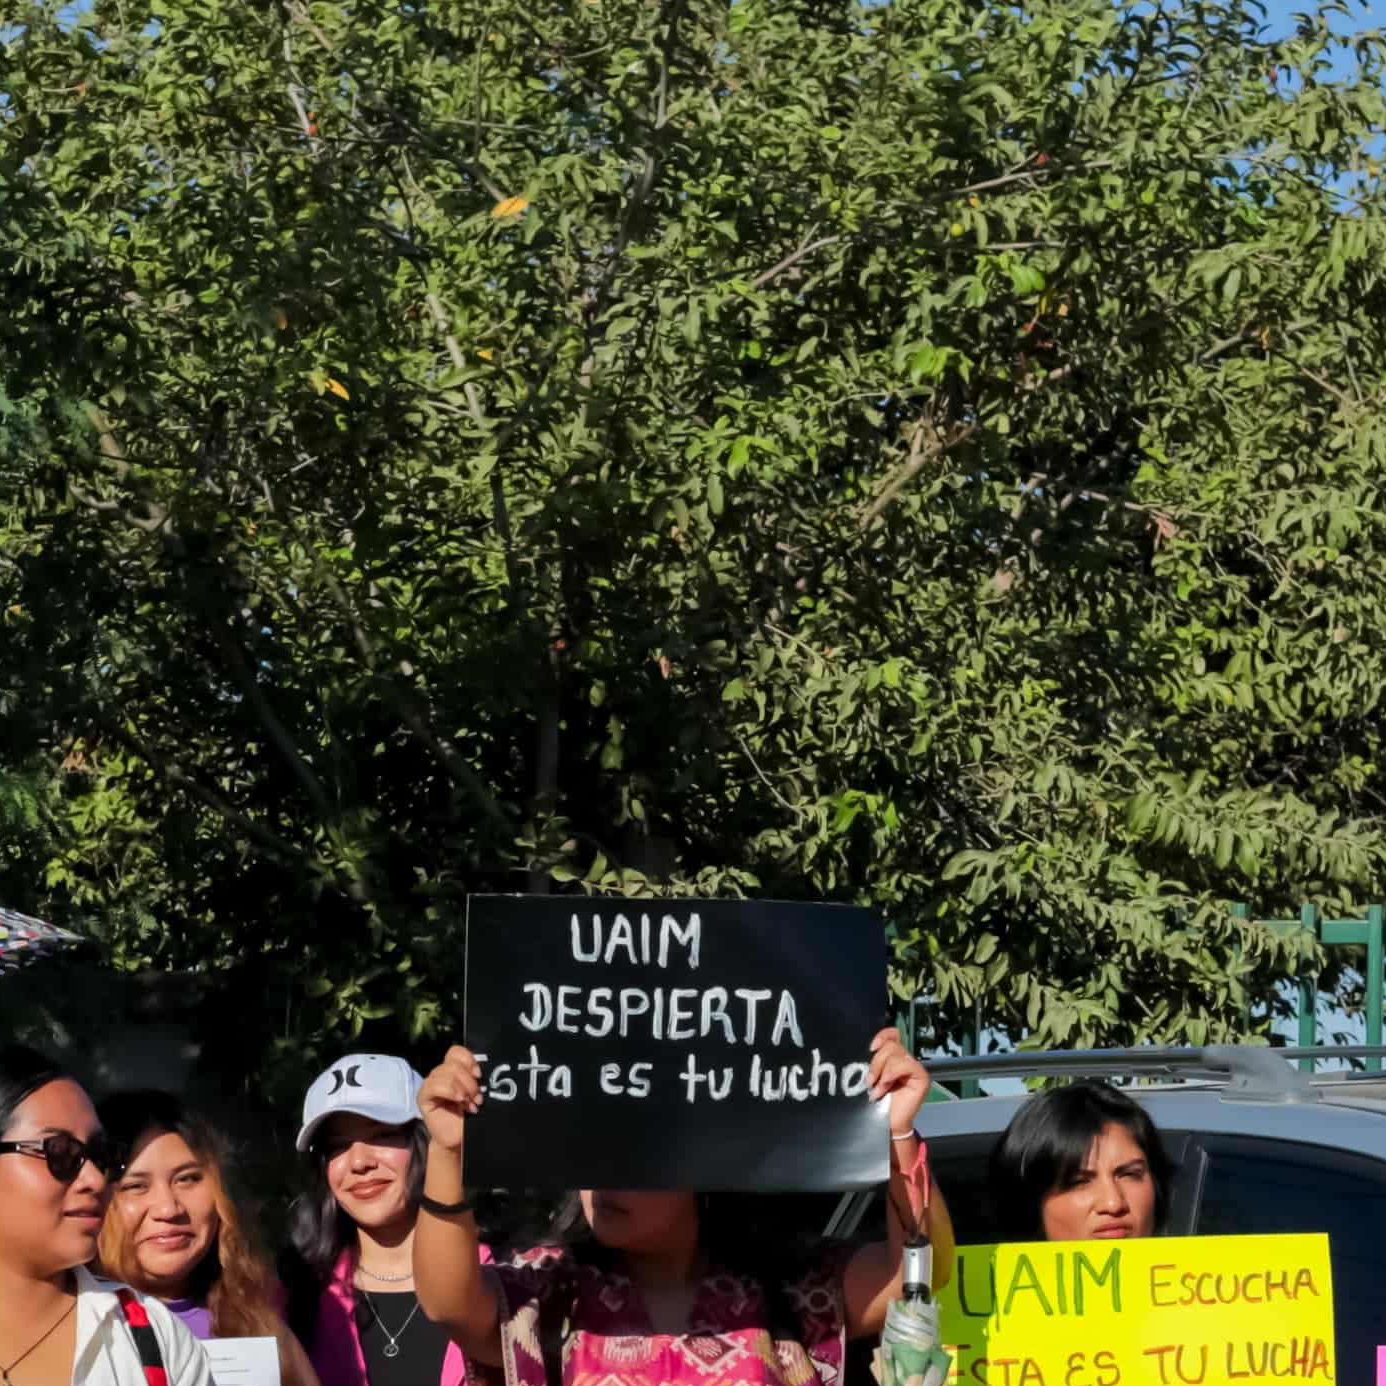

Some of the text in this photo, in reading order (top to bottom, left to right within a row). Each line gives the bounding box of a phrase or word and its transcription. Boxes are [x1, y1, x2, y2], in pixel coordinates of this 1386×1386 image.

[570, 912, 702, 968] UAIM
[518, 982, 804, 1048] DESPIERTA
[600, 1061, 654, 1098] es
[680, 1053, 734, 1104] tu
[957, 1247, 1320, 1330] UAIM ESCUCHA
[1143, 1343, 1208, 1385] TU
[1226, 1335, 1335, 1381] LUCHA
